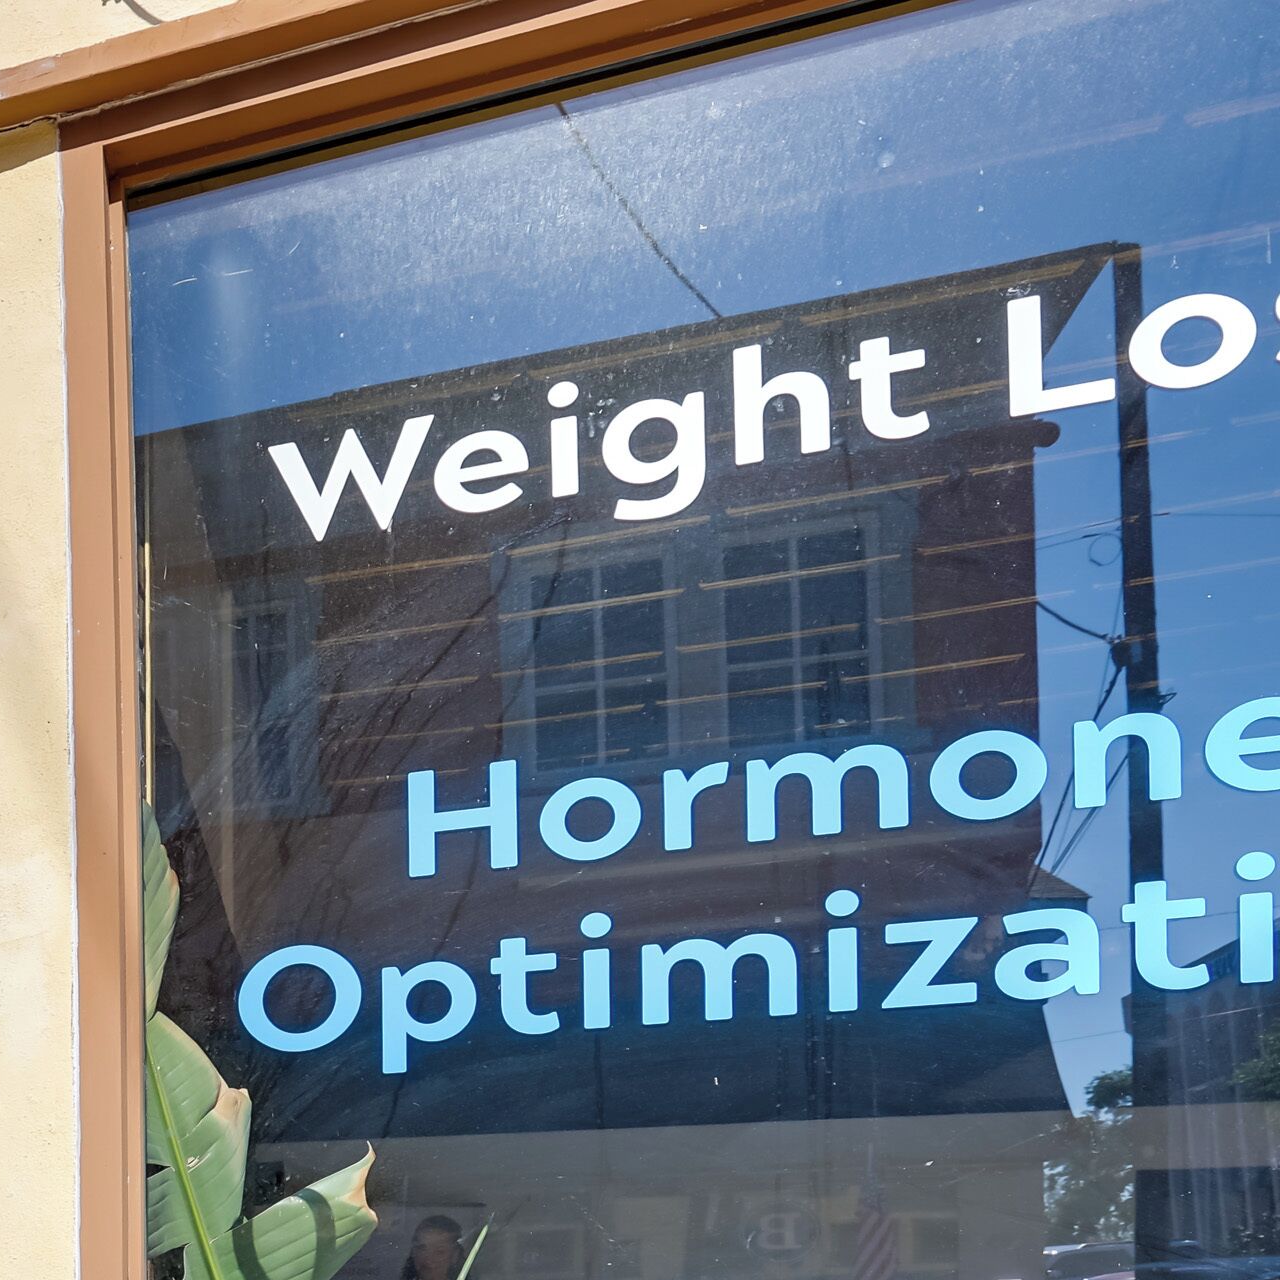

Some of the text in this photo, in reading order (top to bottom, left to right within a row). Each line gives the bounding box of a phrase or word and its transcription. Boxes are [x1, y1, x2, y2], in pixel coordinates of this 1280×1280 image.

[268, 293, 1280, 542] Weight Lo
[406, 696, 1280, 878] Hormone
[238, 851, 1277, 1074] Optimizati
